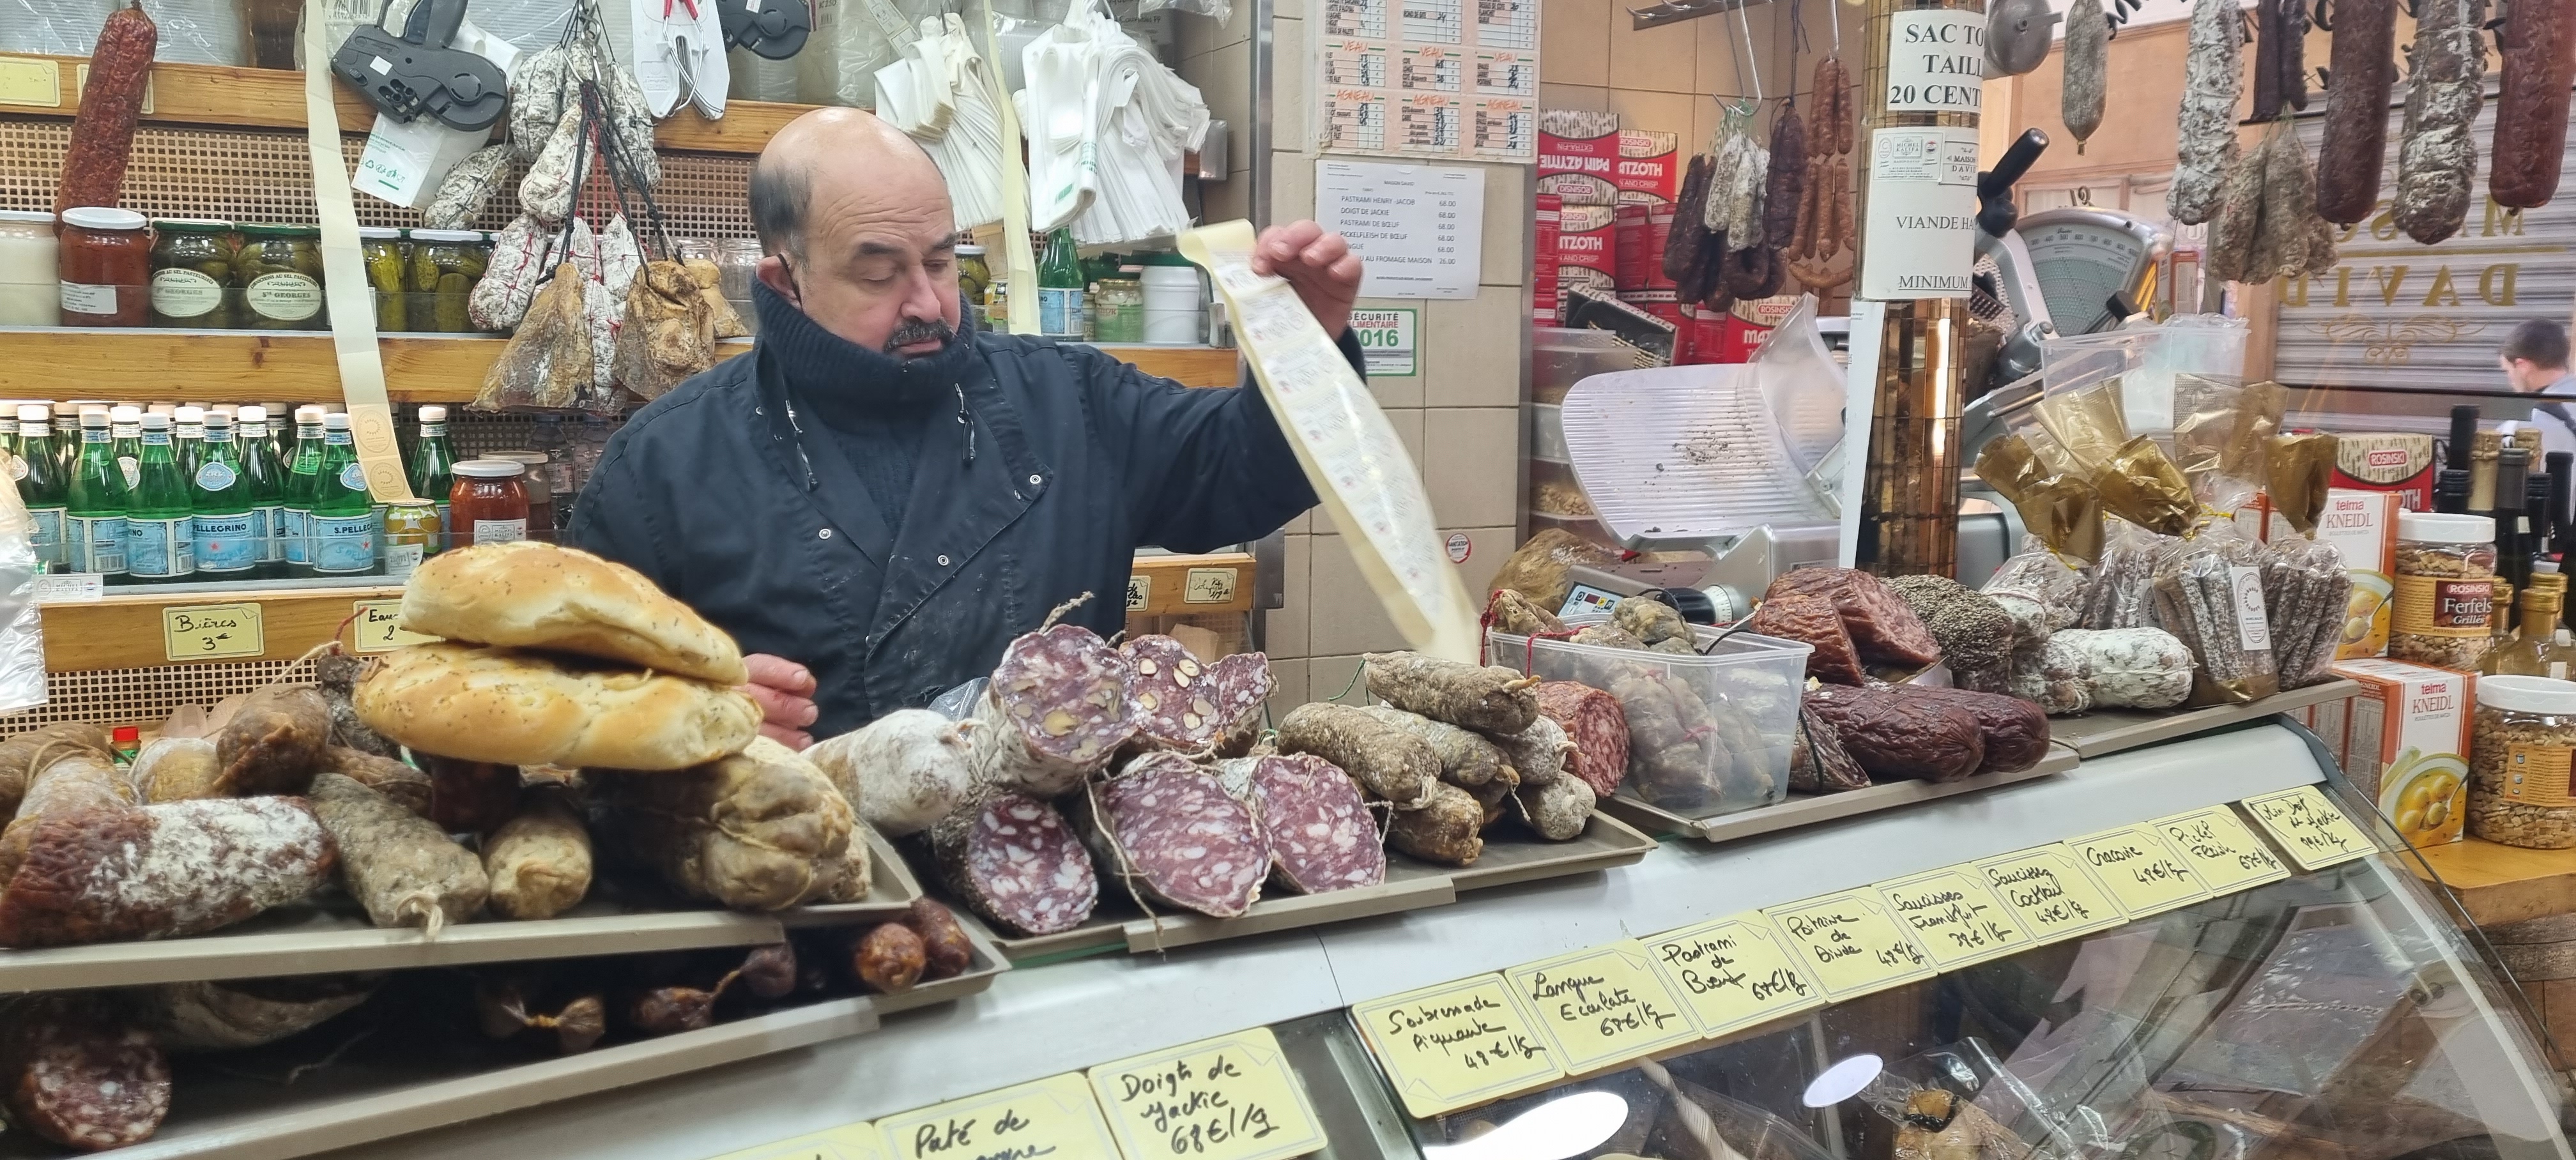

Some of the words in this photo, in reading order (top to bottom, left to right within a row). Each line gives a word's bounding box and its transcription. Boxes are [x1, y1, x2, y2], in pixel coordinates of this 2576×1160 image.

[1905, 24, 1958, 43] SAC
[1343, 41, 1368, 54] VEAU
[1420, 47, 1444, 58] VEAU
[1495, 52, 1517, 63] VEAU
[1337, 89, 1374, 102] AGNEAU
[1414, 94, 1450, 105] AGNEAU
[1890, 84, 1916, 104] 20
[1924, 84, 1981, 108] CENT
[1487, 98, 1522, 111] AGNEAU
[1540, 155, 1583, 169] AZYME
[1584, 157, 1609, 171] PAIN
[1619, 162, 1662, 176] ATZOTH
[1897, 216, 1959, 229] VIANDE
[1559, 236, 1603, 250] TZOTH
[1899, 275, 1969, 289] MINIMUM
[1760, 305, 1791, 314] ROSINSK
[1357, 329, 1399, 346] 016
[2371, 452, 2404, 465] ROSINSKI
[2336, 500, 2365, 511] telma
[2326, 512, 2373, 528] KNEIDL
[193, 523, 247, 532] PELLEGRINO
[334, 524, 372, 534] S.PELLEG
[2450, 584, 2490, 593] ROSINSKI
[2444, 597, 2493, 614] Ferfels
[2453, 615, 2485, 624] Grillés
[2361, 682, 2381, 691] KNEIDL
[2421, 683, 2447, 695] telma
[2412, 695, 2454, 714] KNEIDL
[1830, 928, 1851, 943] de
[1711, 954, 1734, 969] de
[1208, 1054, 1241, 1081] de
[993, 1108, 1031, 1136] de
